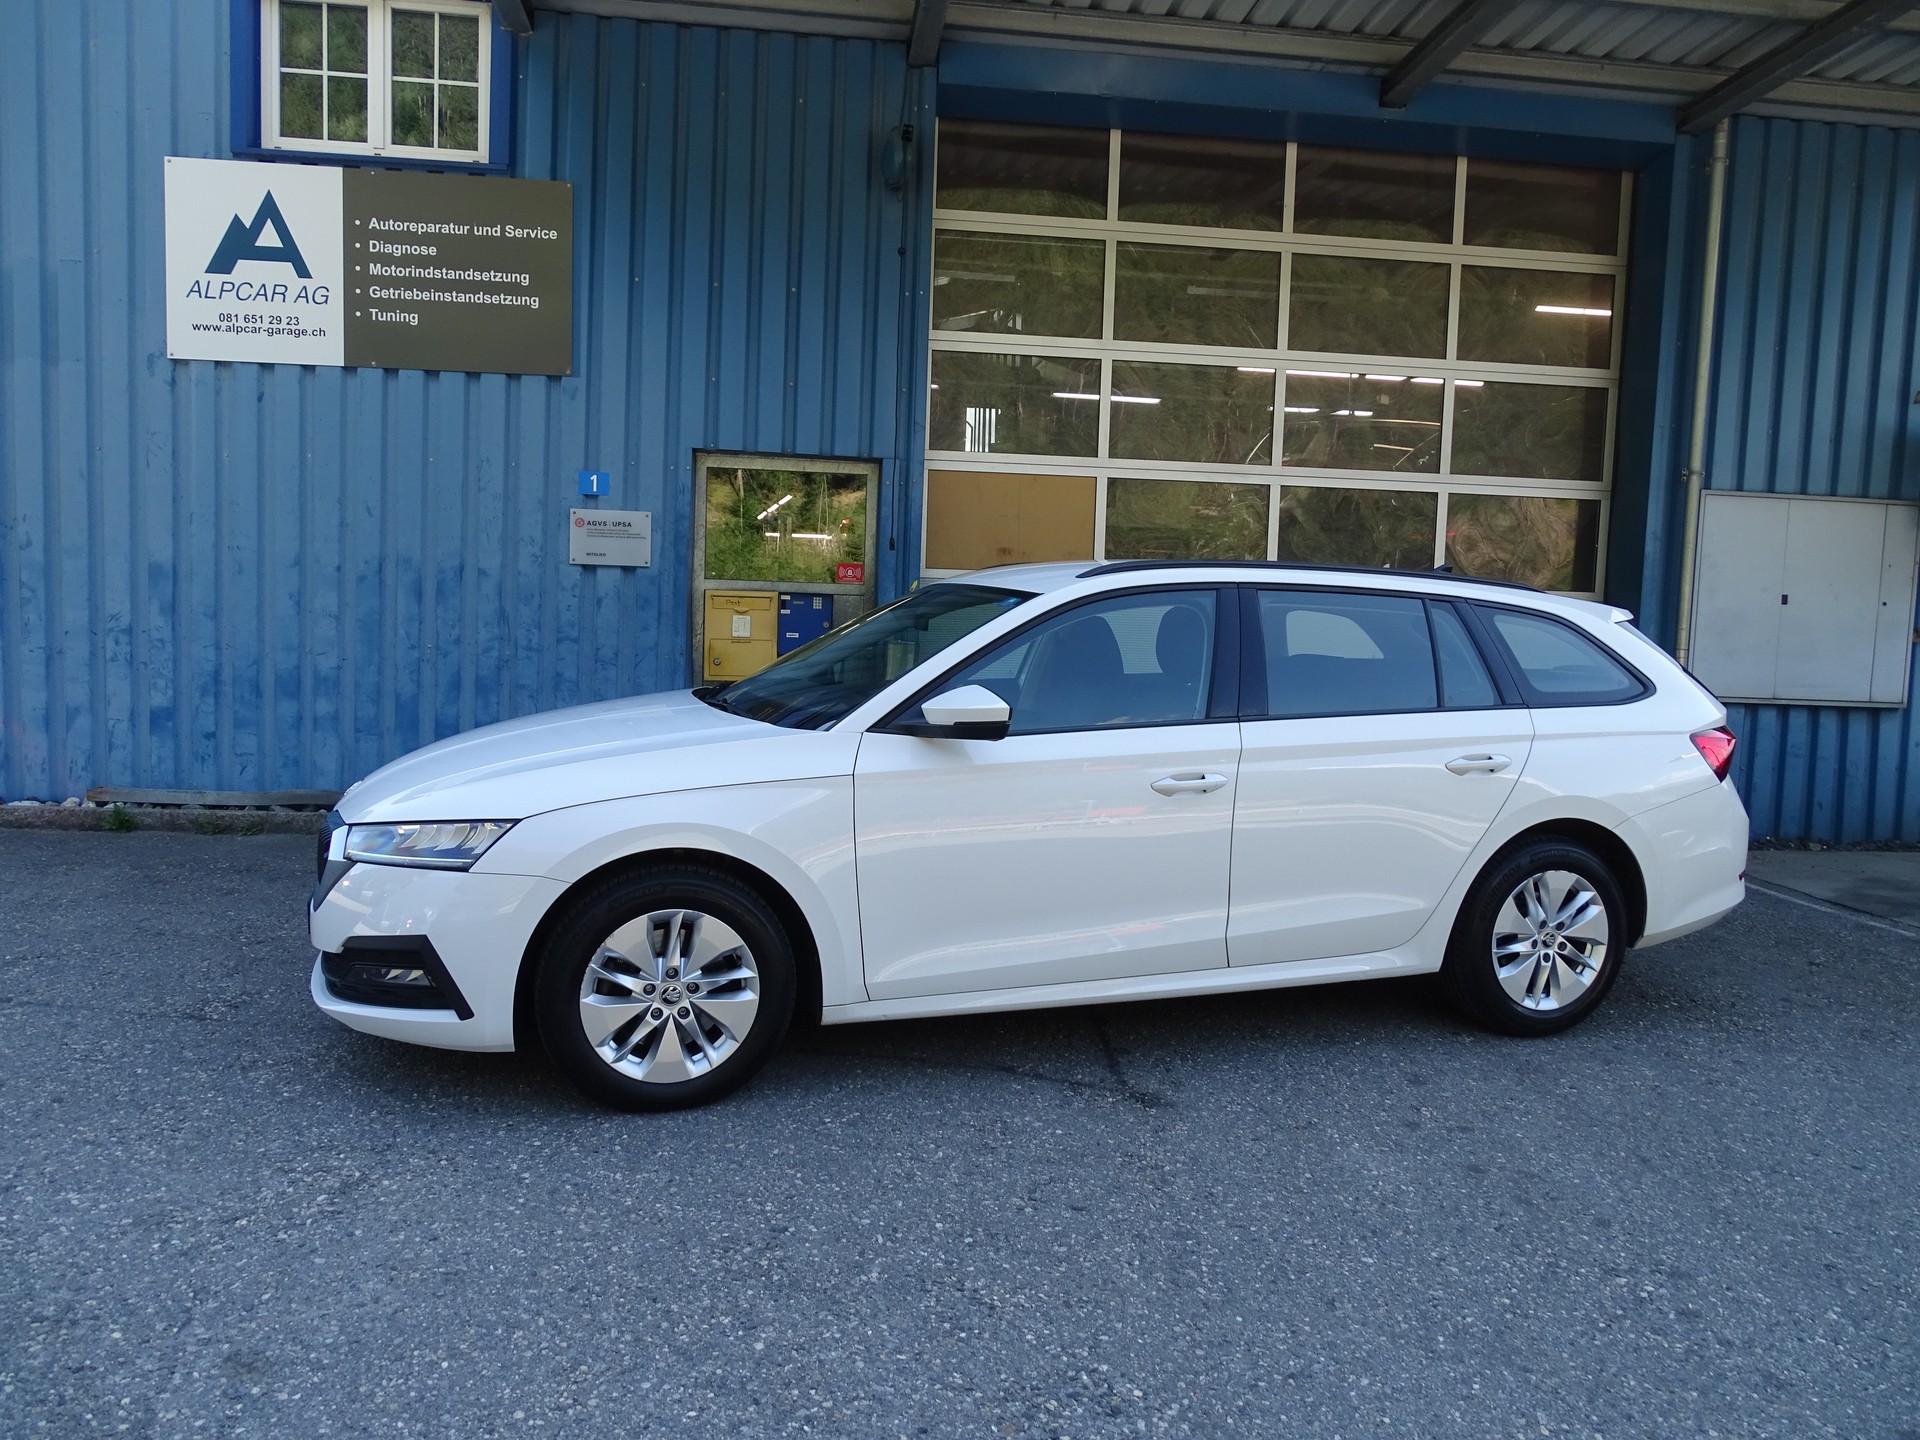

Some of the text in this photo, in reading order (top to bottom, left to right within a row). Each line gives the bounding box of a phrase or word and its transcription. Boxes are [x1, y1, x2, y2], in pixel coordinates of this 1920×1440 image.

[368, 217, 558, 240] Autoreparatur und Service
[368, 240, 438, 257] Diagnose
[368, 262, 530, 286] Motorindstandsetzung
[186, 279, 330, 305] ALPCAR AG
[368, 285, 540, 309] Getriebeinstandsetzung
[218, 312, 300, 327] 081 651 29 23
[368, 308, 419, 326] Tuning
[191, 322, 327, 339] www.alpcar-garage.ch
[590, 474, 598, 492] 1
